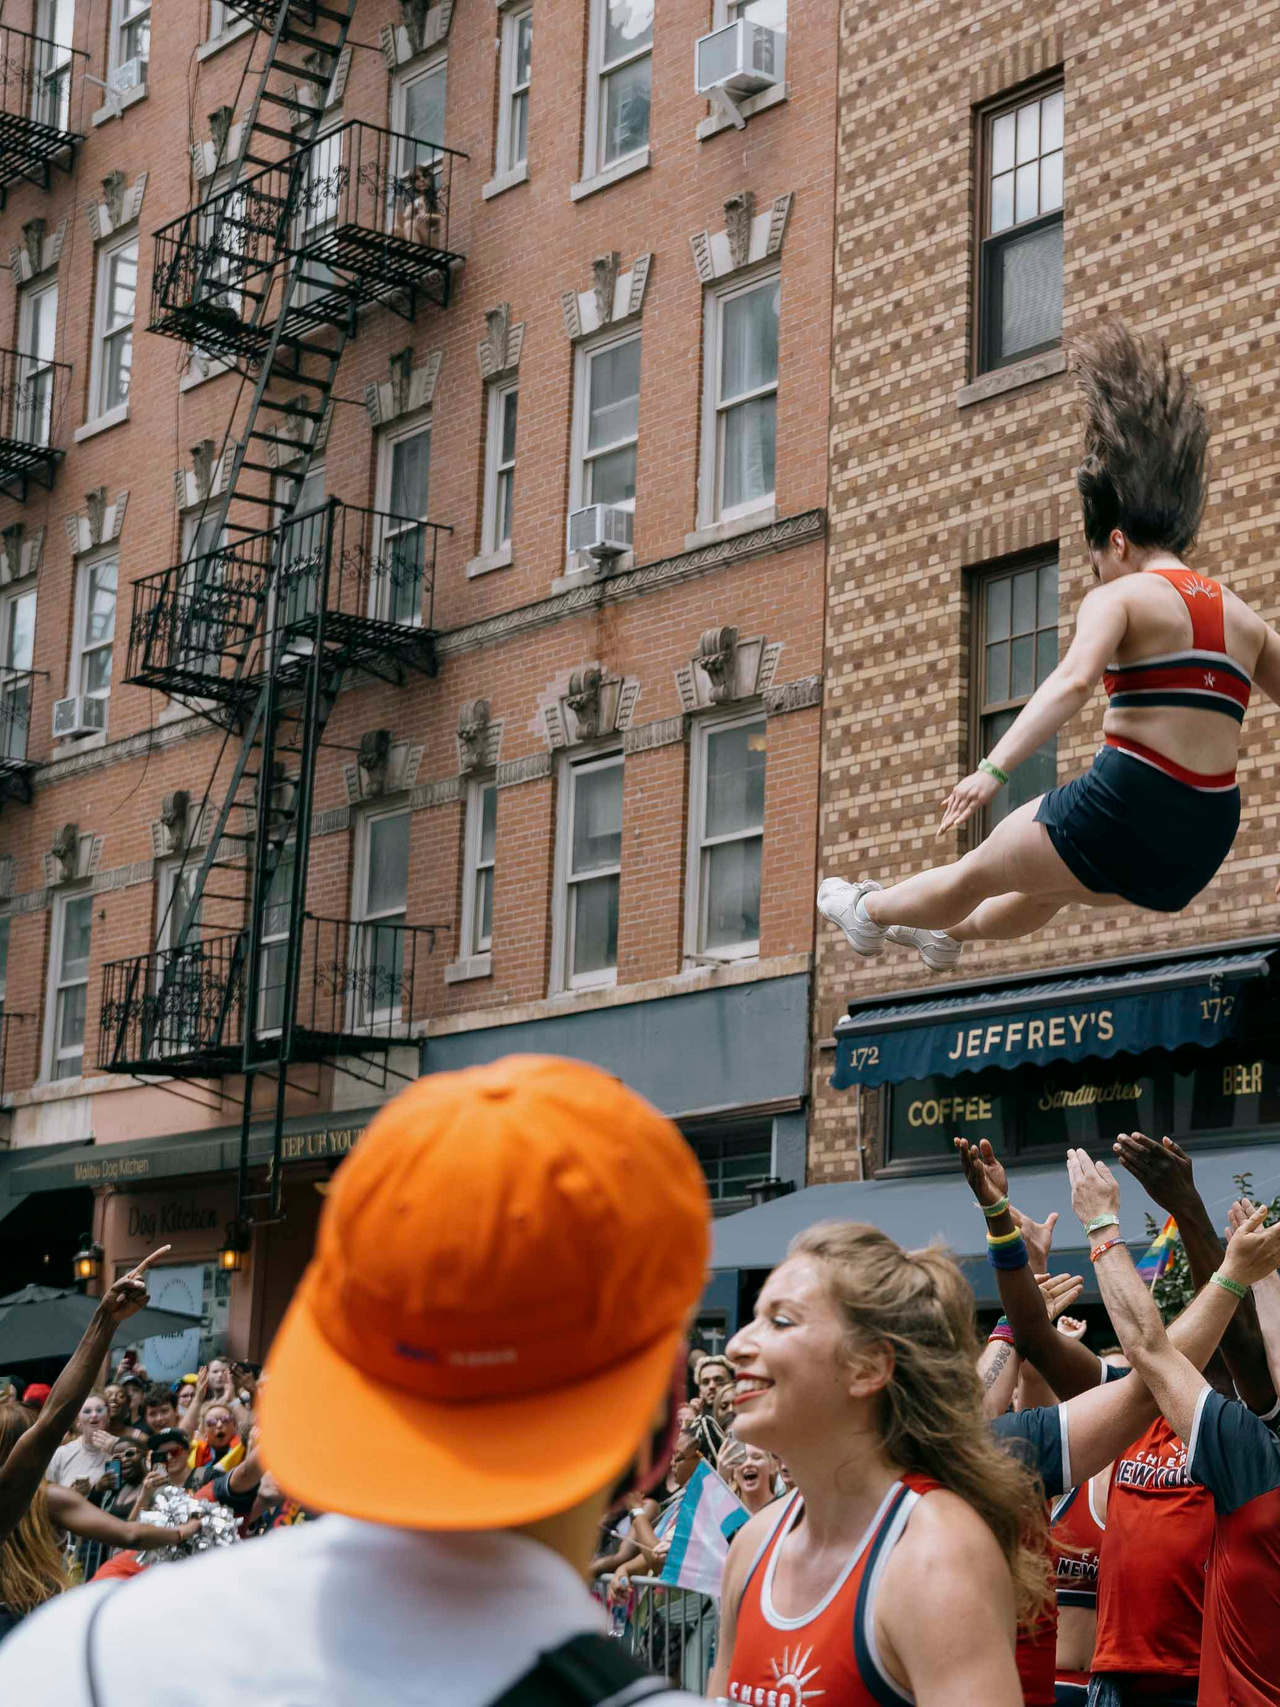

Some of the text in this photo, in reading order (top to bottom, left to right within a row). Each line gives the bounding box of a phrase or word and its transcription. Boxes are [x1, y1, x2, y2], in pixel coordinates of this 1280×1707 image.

[1200, 995, 1235, 1024] 172
[948, 1010, 1115, 1060] JEFFREY'S
[850, 1046, 880, 1071] 172
[1223, 1062, 1263, 1096] BEER
[908, 1094, 993, 1127] COFFEE
[1038, 1080, 1143, 1111] Sandwiches
[281, 1134, 305, 1158] TEP
[102, 1160, 119, 1180] Dog
[120, 1157, 149, 1175] Kitchen
[128, 1201, 218, 1245] Dog Kitchen
[1136, 1450, 1187, 1467] CHER
